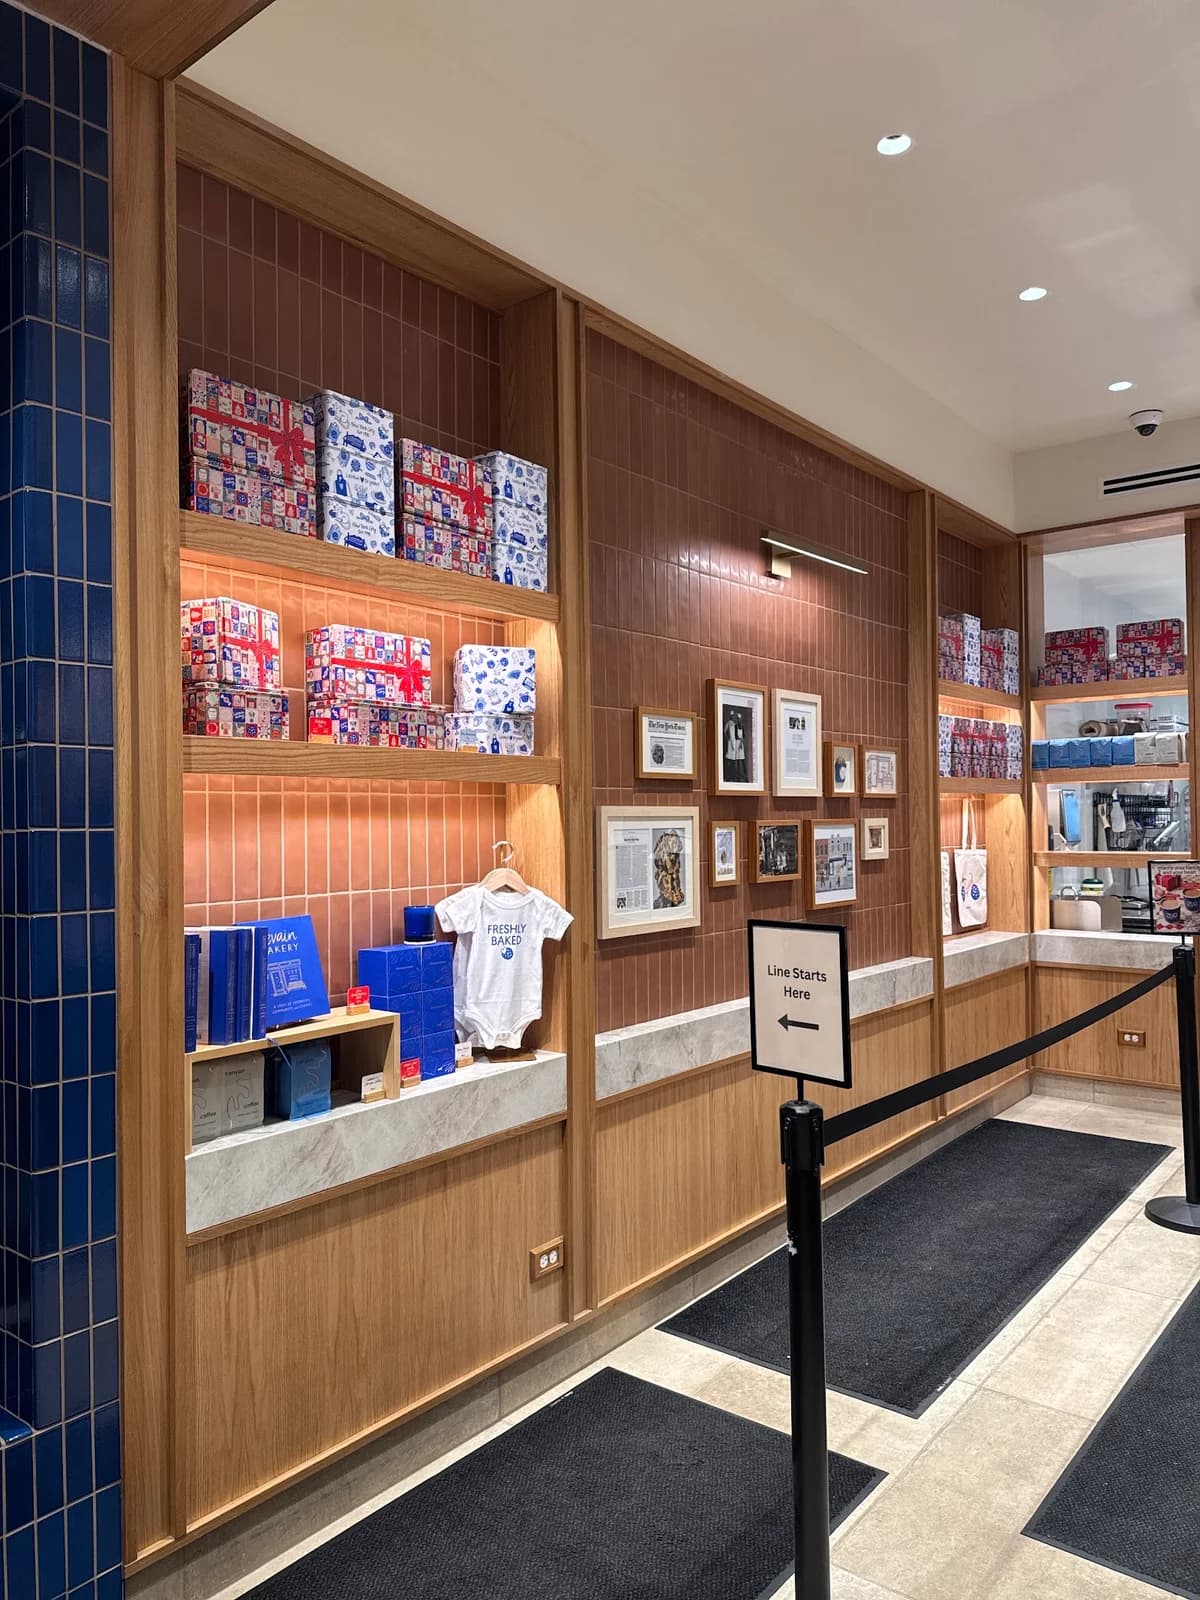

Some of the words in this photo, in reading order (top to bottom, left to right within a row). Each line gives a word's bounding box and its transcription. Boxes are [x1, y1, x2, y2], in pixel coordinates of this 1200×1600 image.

[487, 923, 527, 935] FRESHLY
[267, 929, 297, 945] evain
[491, 935, 522, 946] BAKED
[267, 943, 299, 955] AKERY
[767, 964, 791, 978] Line
[792, 967, 827, 983] Starts
[783, 986, 811, 1000] Here
